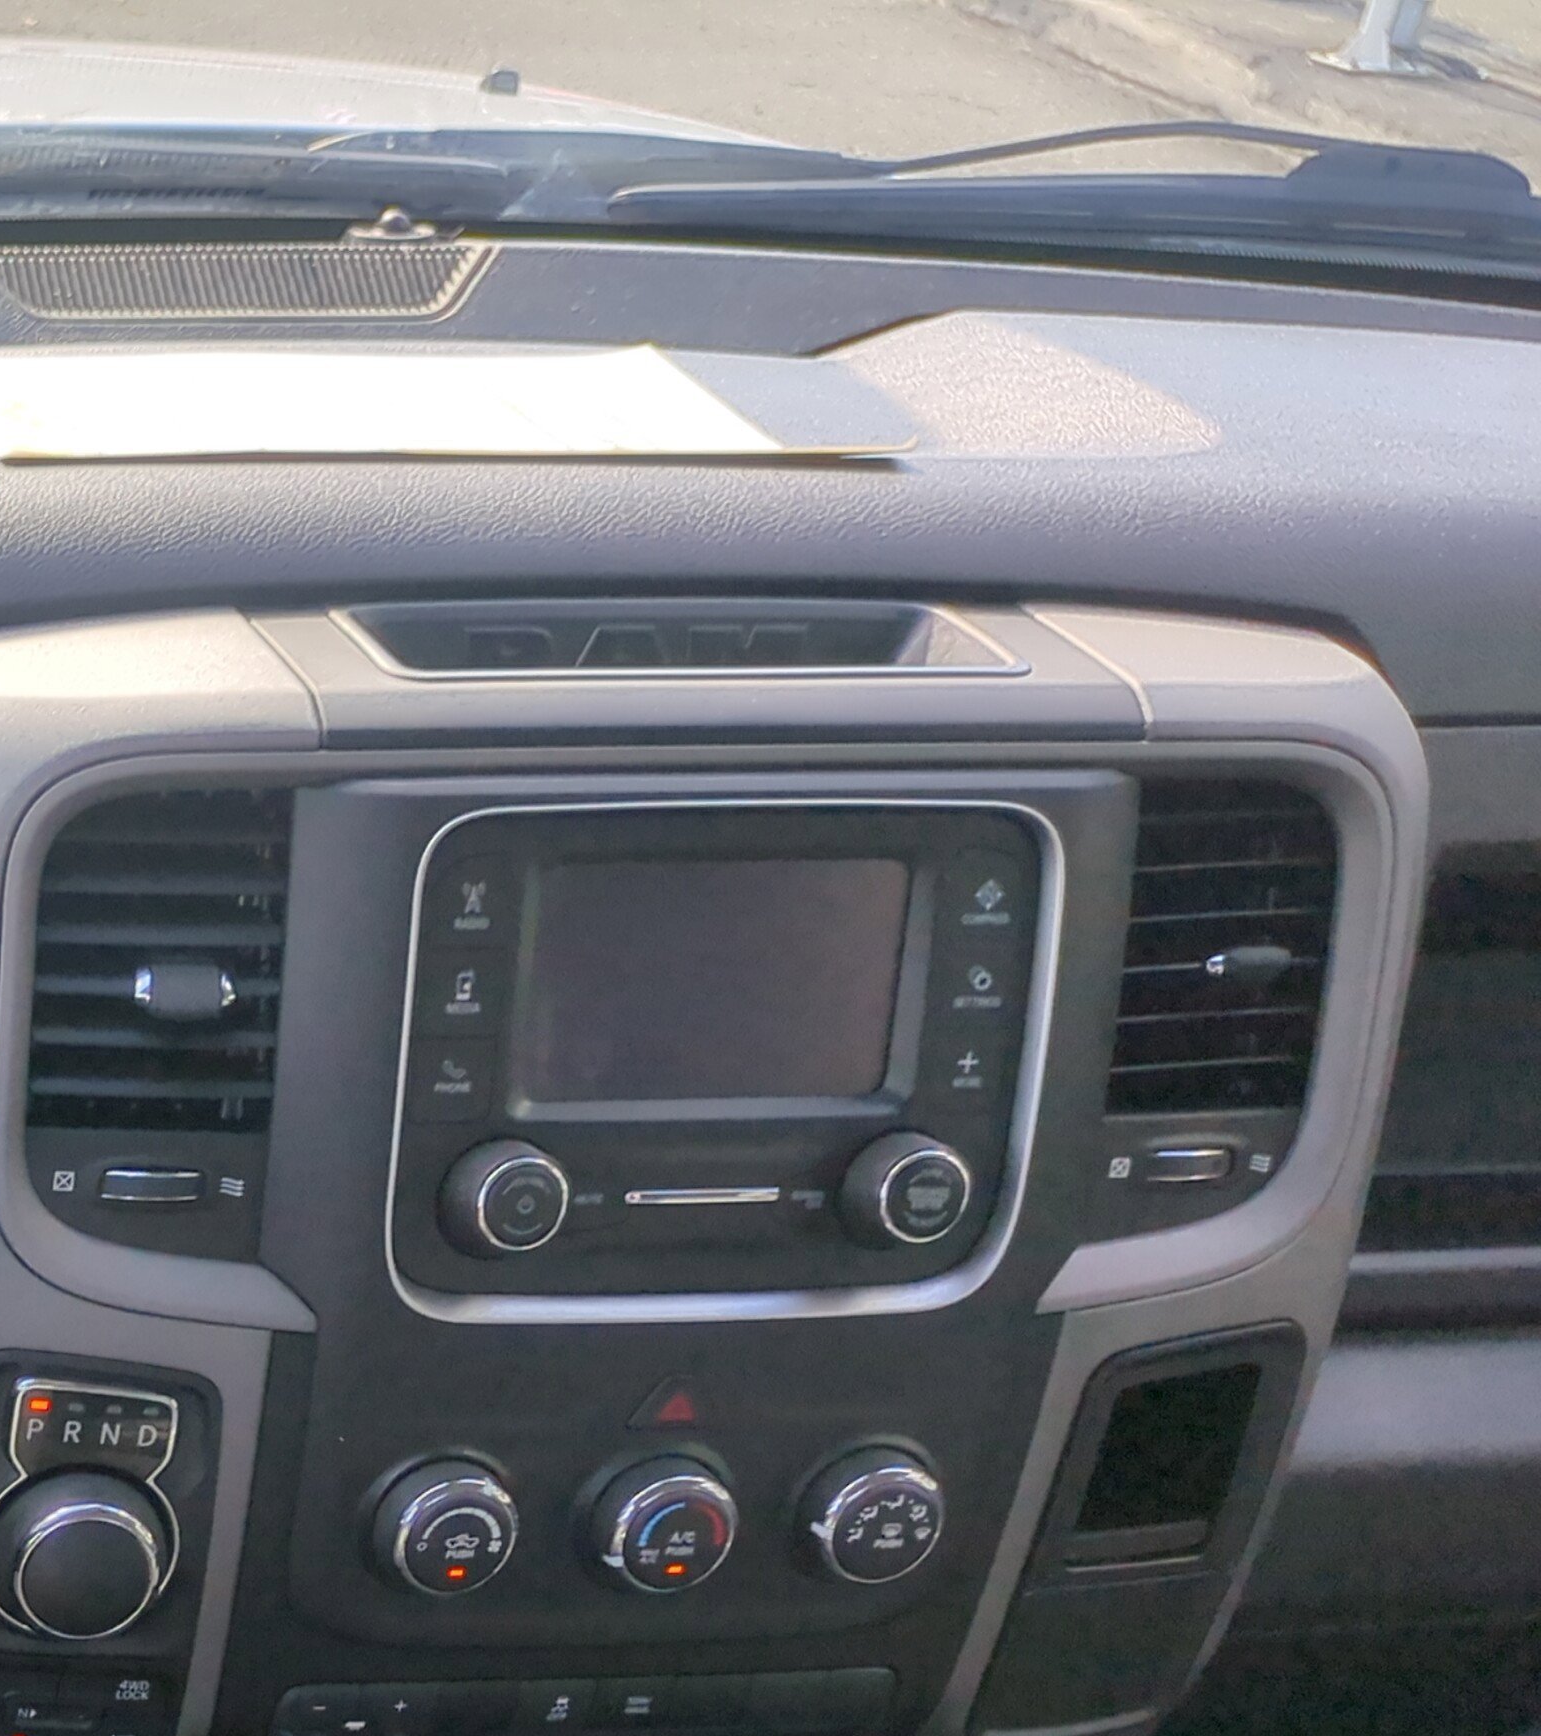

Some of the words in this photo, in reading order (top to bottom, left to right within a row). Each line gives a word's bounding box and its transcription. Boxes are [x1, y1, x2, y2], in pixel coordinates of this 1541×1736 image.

[26, 1418, 45, 1441] P
[62, 1420, 82, 1443] R
[99, 1422, 121, 1445] N
[137, 1424, 159, 1447] D
[119, 1680, 151, 1691] 4WD
[116, 1690, 149, 1701] LOCK
